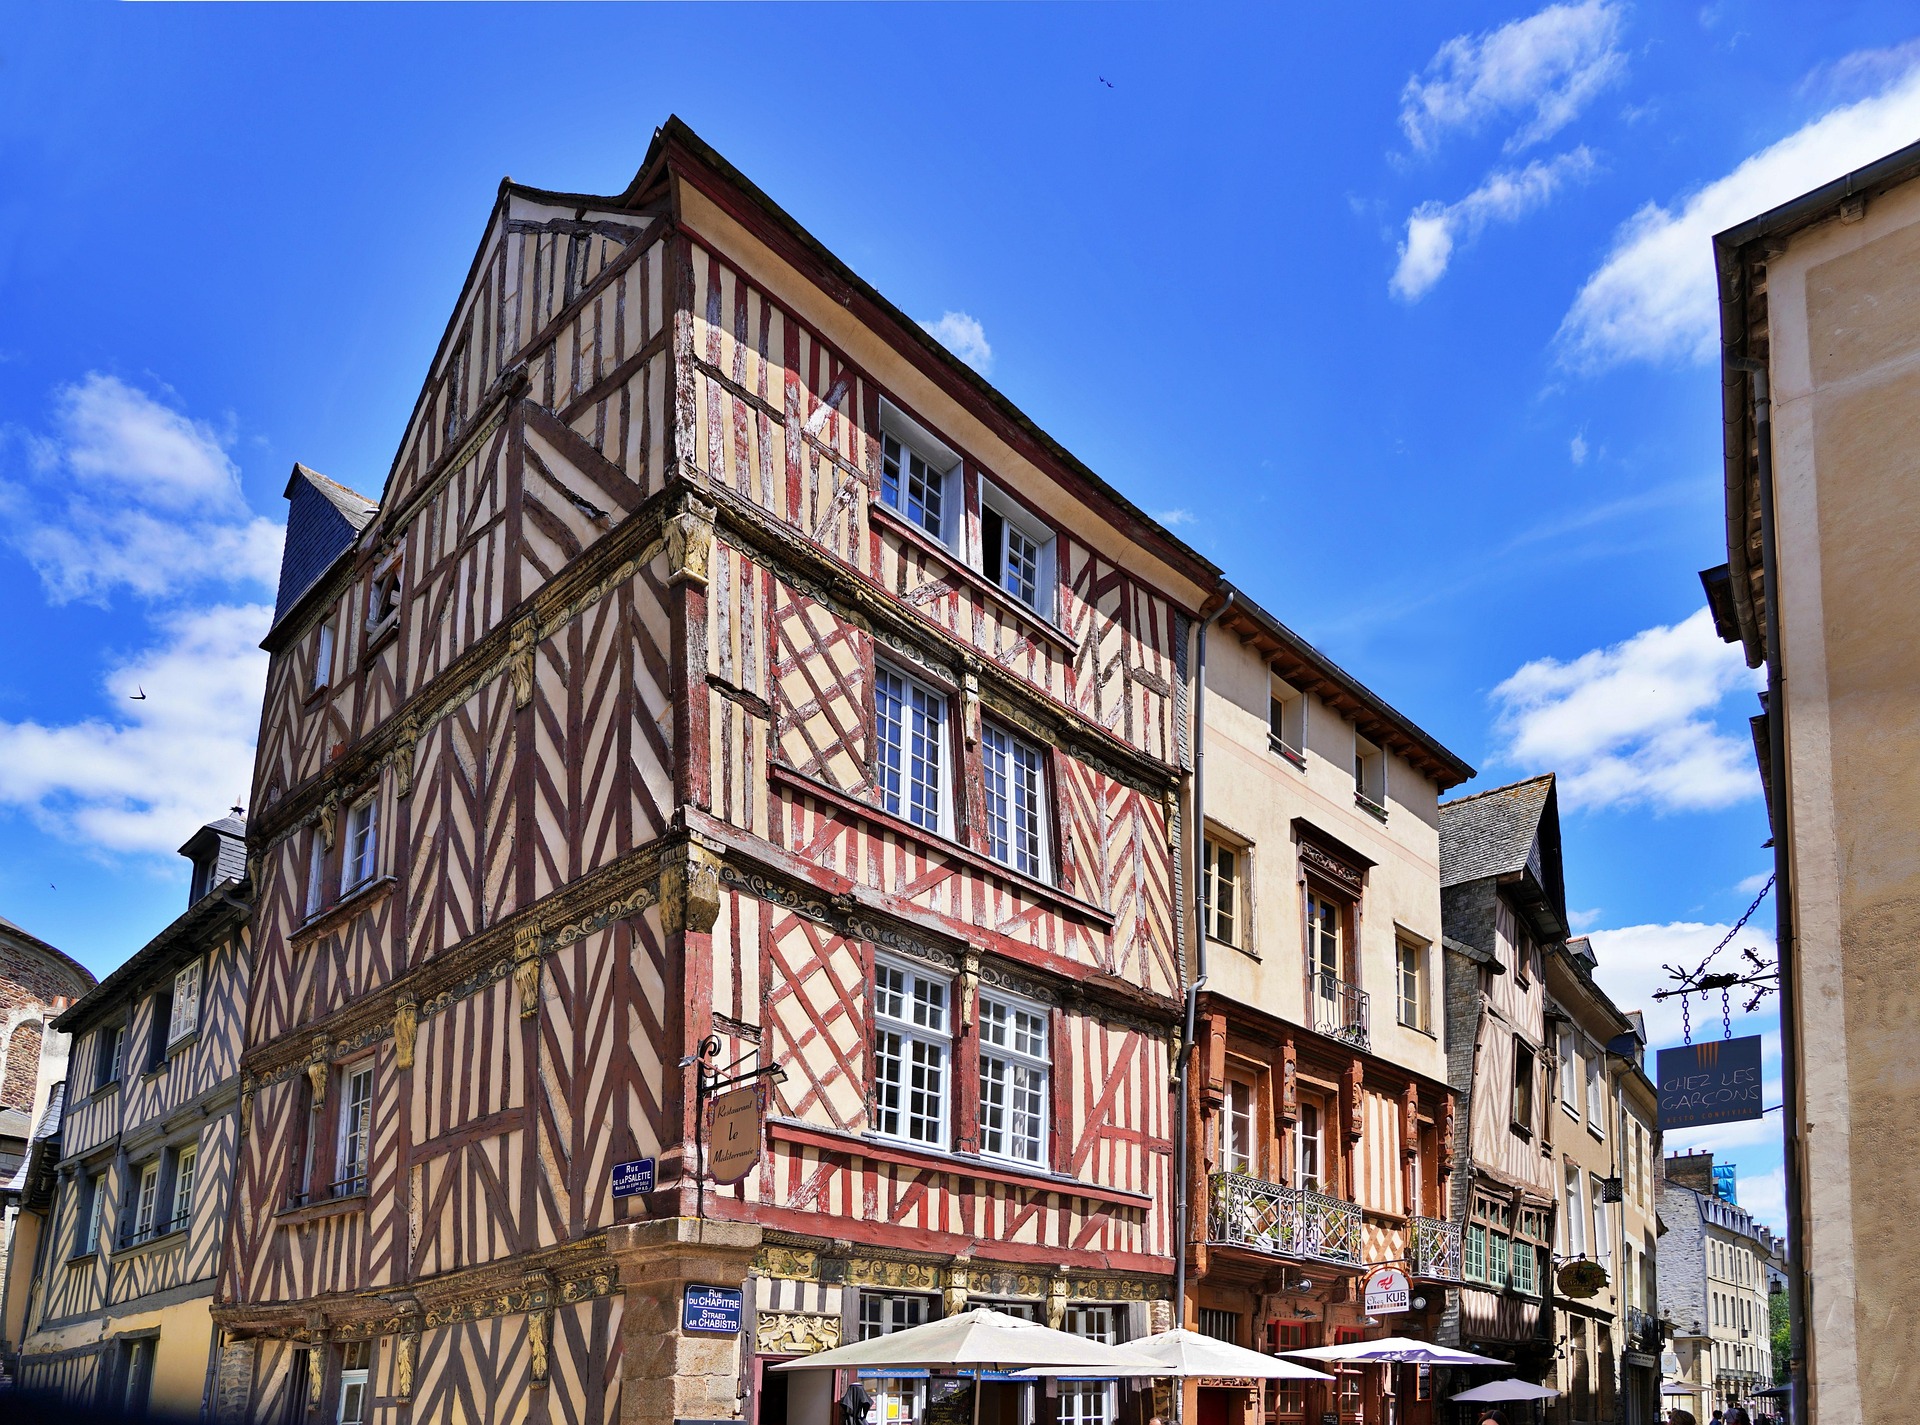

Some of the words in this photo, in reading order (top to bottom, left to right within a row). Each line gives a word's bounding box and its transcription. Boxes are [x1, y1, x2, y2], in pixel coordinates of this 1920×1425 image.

[1663, 1074, 1711, 1092] CHEZ
[1721, 1067, 1755, 1085] LES
[1661, 1085, 1760, 1110] GARÇONS
[717, 1100, 753, 1118] Restaurant
[1667, 1113, 1695, 1123] RESTO
[1701, 1107, 1753, 1120] CONVIVIAL
[626, 1165, 639, 1174] RUE
[624, 1170, 651, 1183] PSALETTE
[708, 1289, 722, 1299] RUE
[1386, 1292, 1407, 1303] KUB
[698, 1296, 740, 1309] CHAPITRE
[702, 1310, 726, 1320] STRAED
[698, 1318, 737, 1330] CHABISTR
